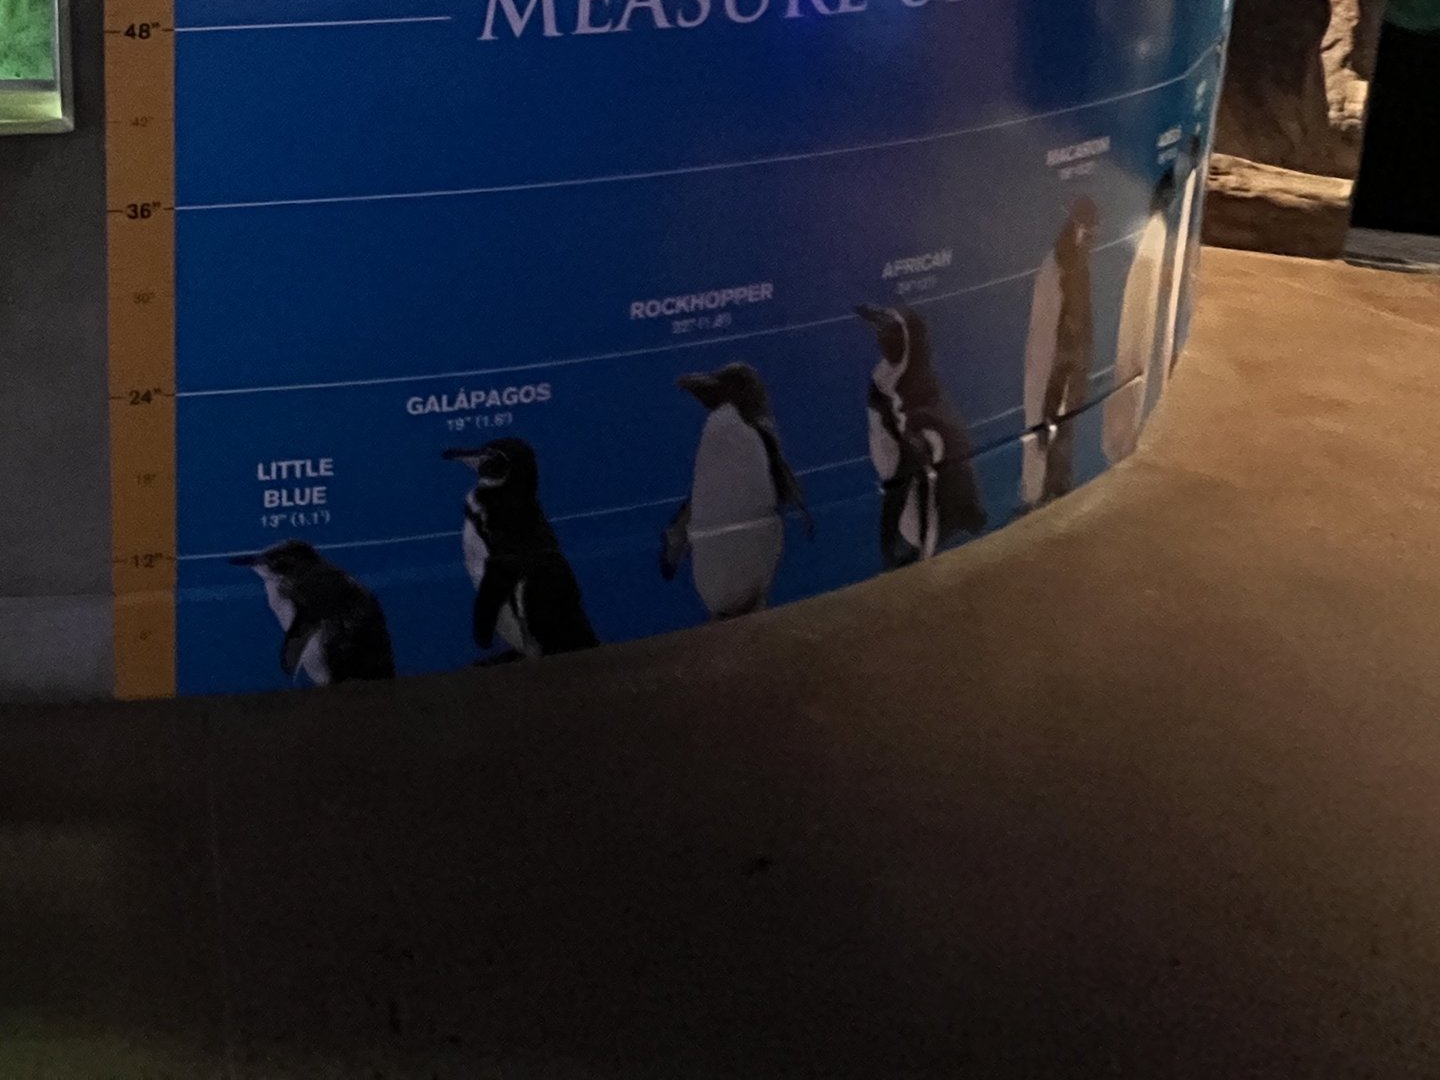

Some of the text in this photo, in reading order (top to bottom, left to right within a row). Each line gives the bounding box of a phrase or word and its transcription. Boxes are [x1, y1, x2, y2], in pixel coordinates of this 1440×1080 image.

[123, 21, 160, 40] 48"
[126, 201, 161, 221] 36"
[630, 281, 775, 321] ROCKHOPPER
[129, 387, 161, 406] 24"
[406, 382, 552, 416] GALÁPAGOS
[257, 458, 335, 481] LITTLE
[263, 486, 328, 509] BLUE
[131, 552, 163, 569] 12"
